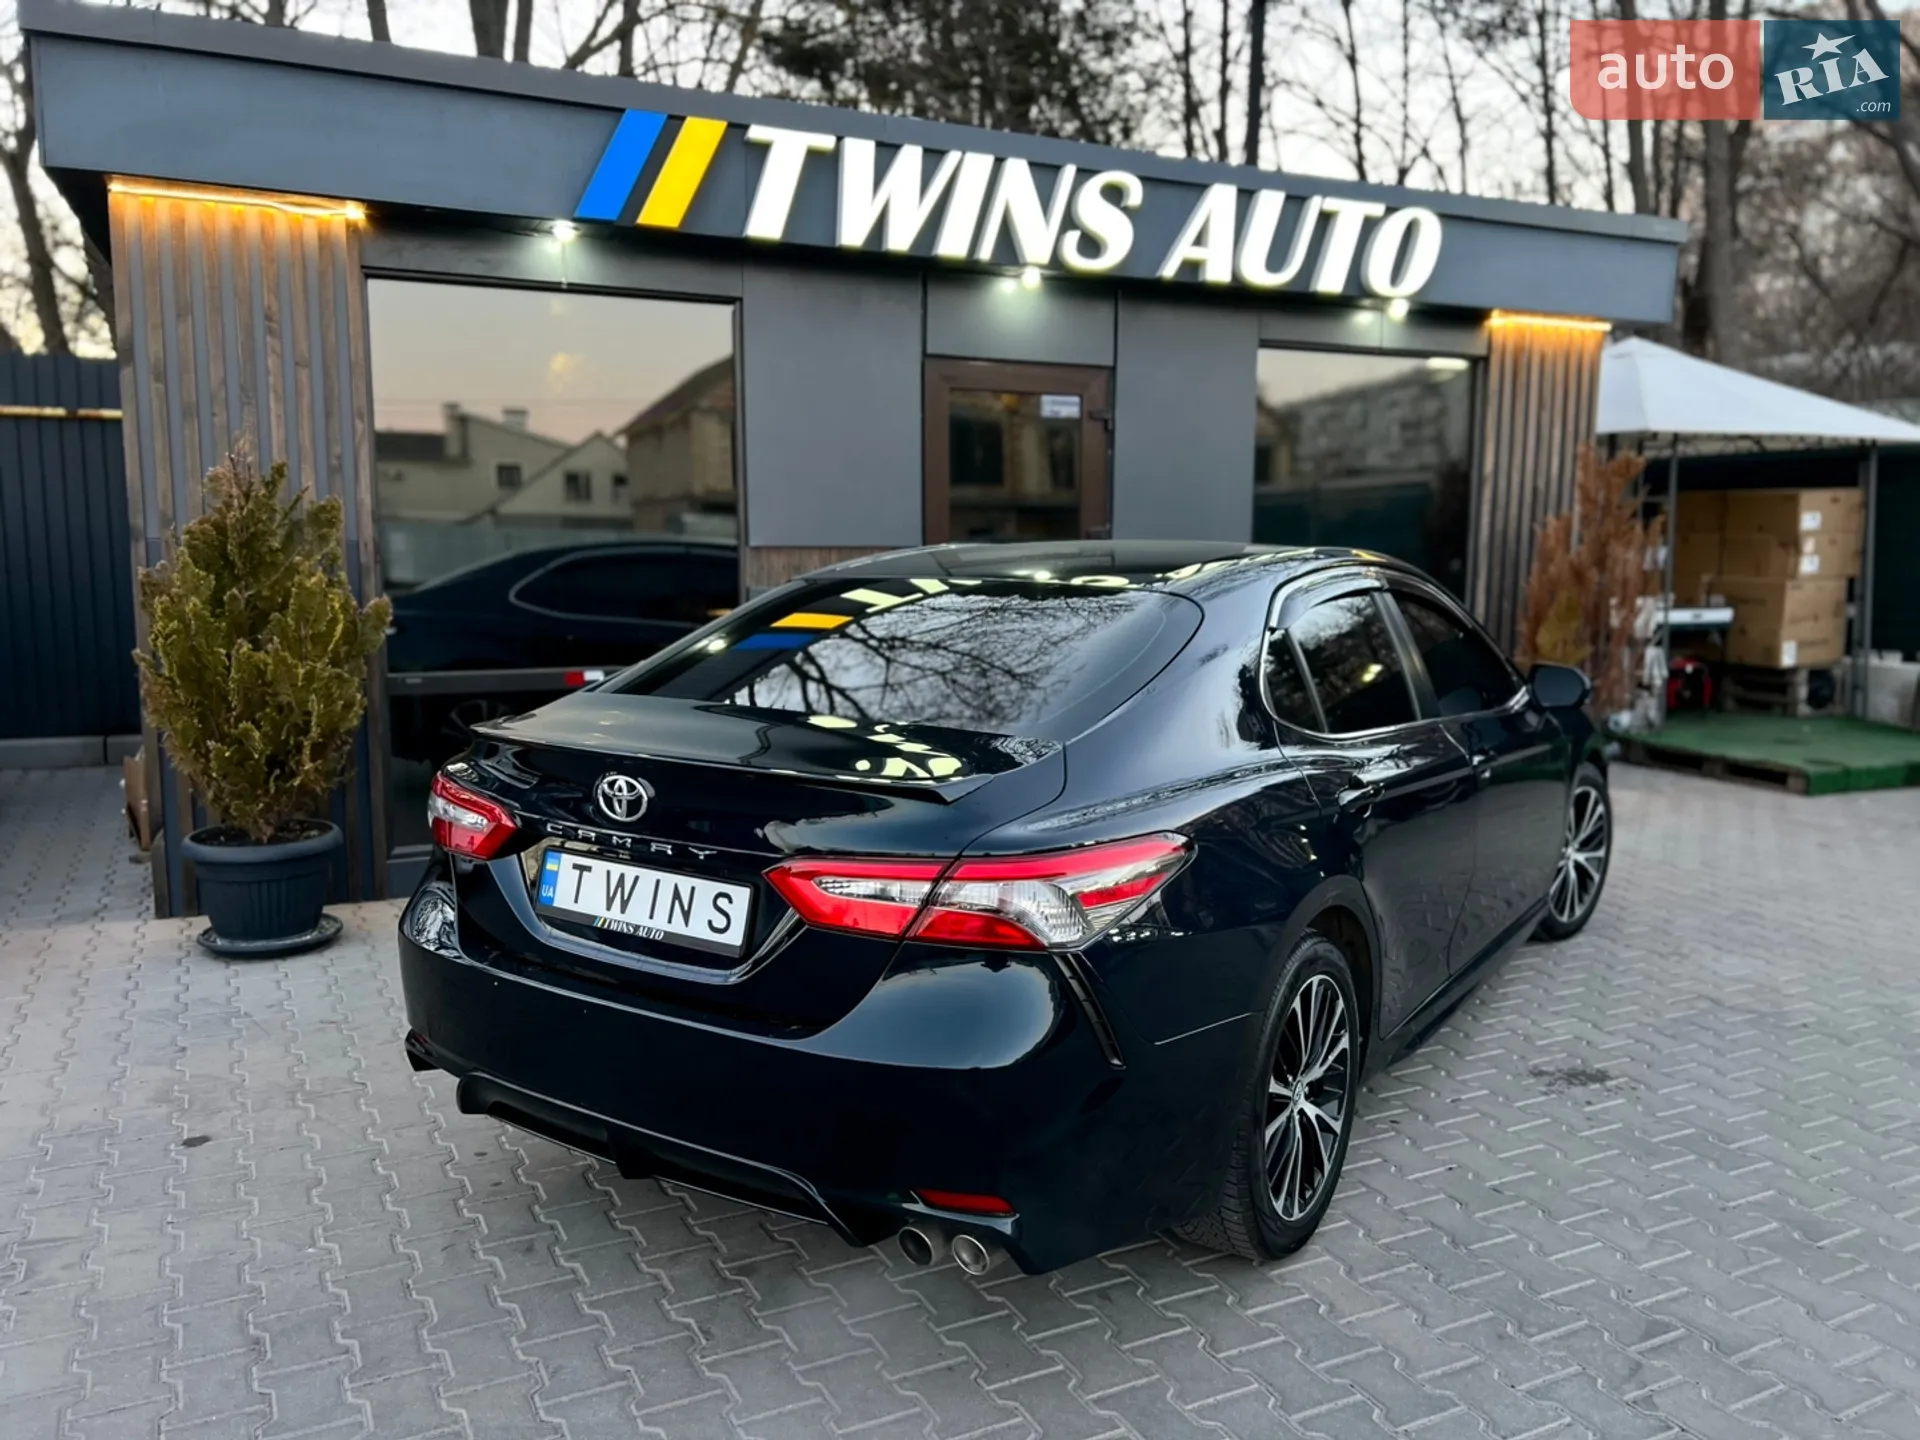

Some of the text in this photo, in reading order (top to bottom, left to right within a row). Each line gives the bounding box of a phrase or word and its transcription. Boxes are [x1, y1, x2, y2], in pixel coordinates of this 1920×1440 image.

[743, 124, 1443, 298] TWINS AUTO
[547, 822, 717, 860] CAMRY
[541, 884, 554, 898] UA
[571, 862, 734, 935] TWINS
[602, 917, 665, 941] TWINS AUTO
